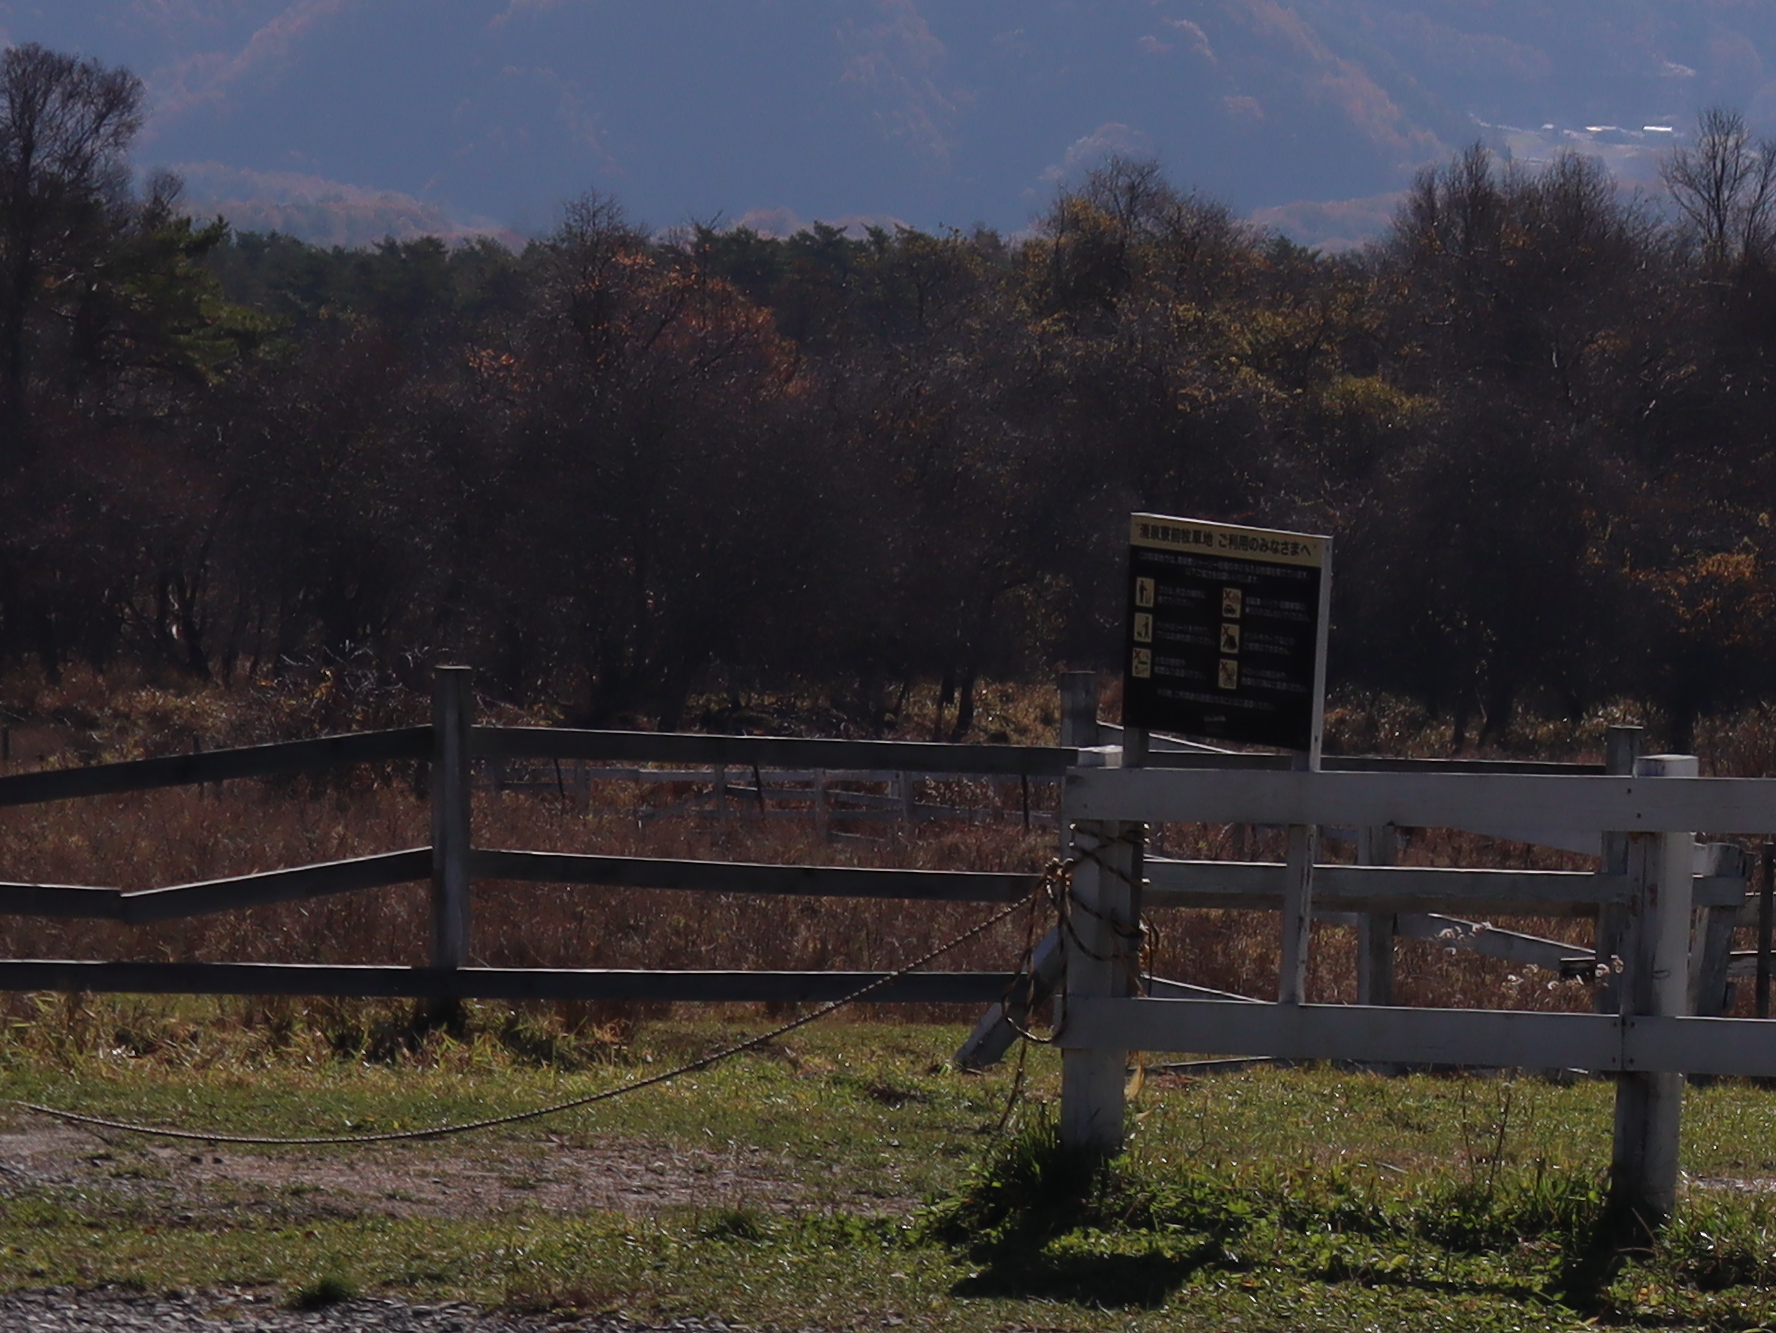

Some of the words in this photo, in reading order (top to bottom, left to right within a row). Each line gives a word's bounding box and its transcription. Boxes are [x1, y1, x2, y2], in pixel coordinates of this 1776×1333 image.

[1218, 533, 1311, 557] ご利用のみなさまへ
